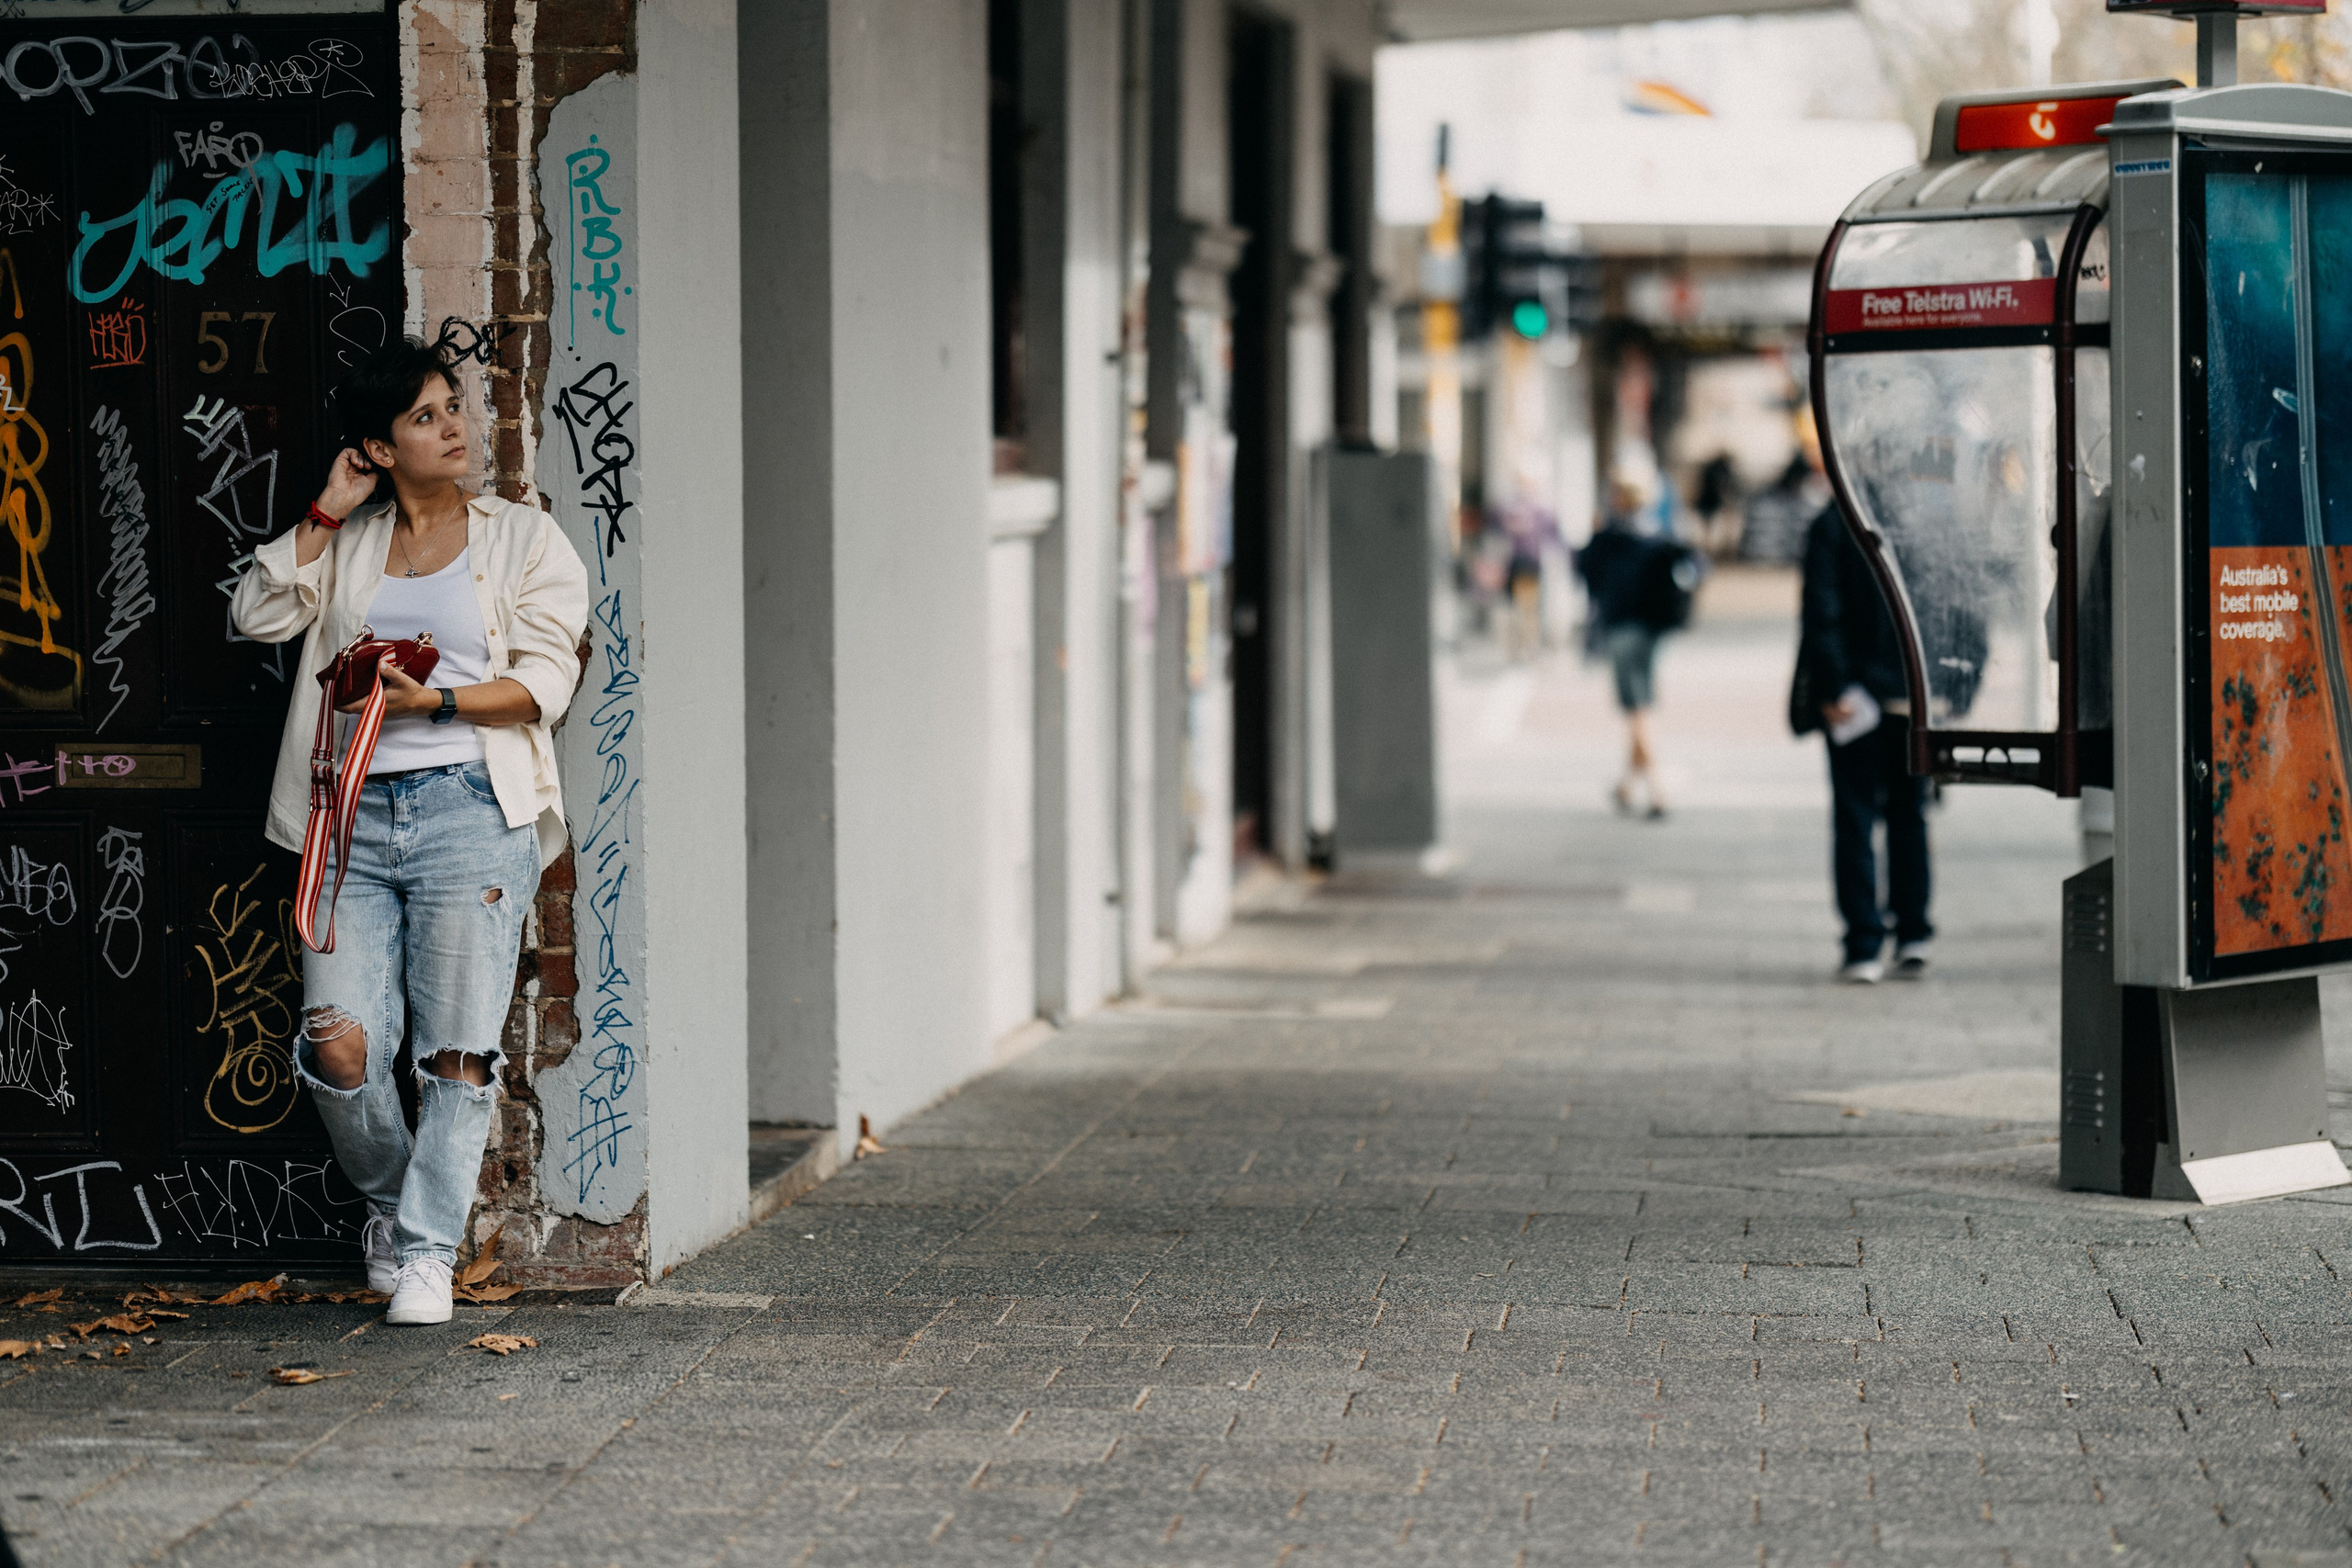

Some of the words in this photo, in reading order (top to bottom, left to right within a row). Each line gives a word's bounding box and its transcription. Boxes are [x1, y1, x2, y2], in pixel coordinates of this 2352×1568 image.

[1861, 292, 1903, 315] Free
[1905, 289, 1965, 312] Telstra
[198, 311, 276, 374] 57
[2220, 564, 2288, 586] Australia's
[2220, 592, 2251, 613] best
[2253, 590, 2299, 612] mobile
[2220, 623, 2286, 642] coverage.
